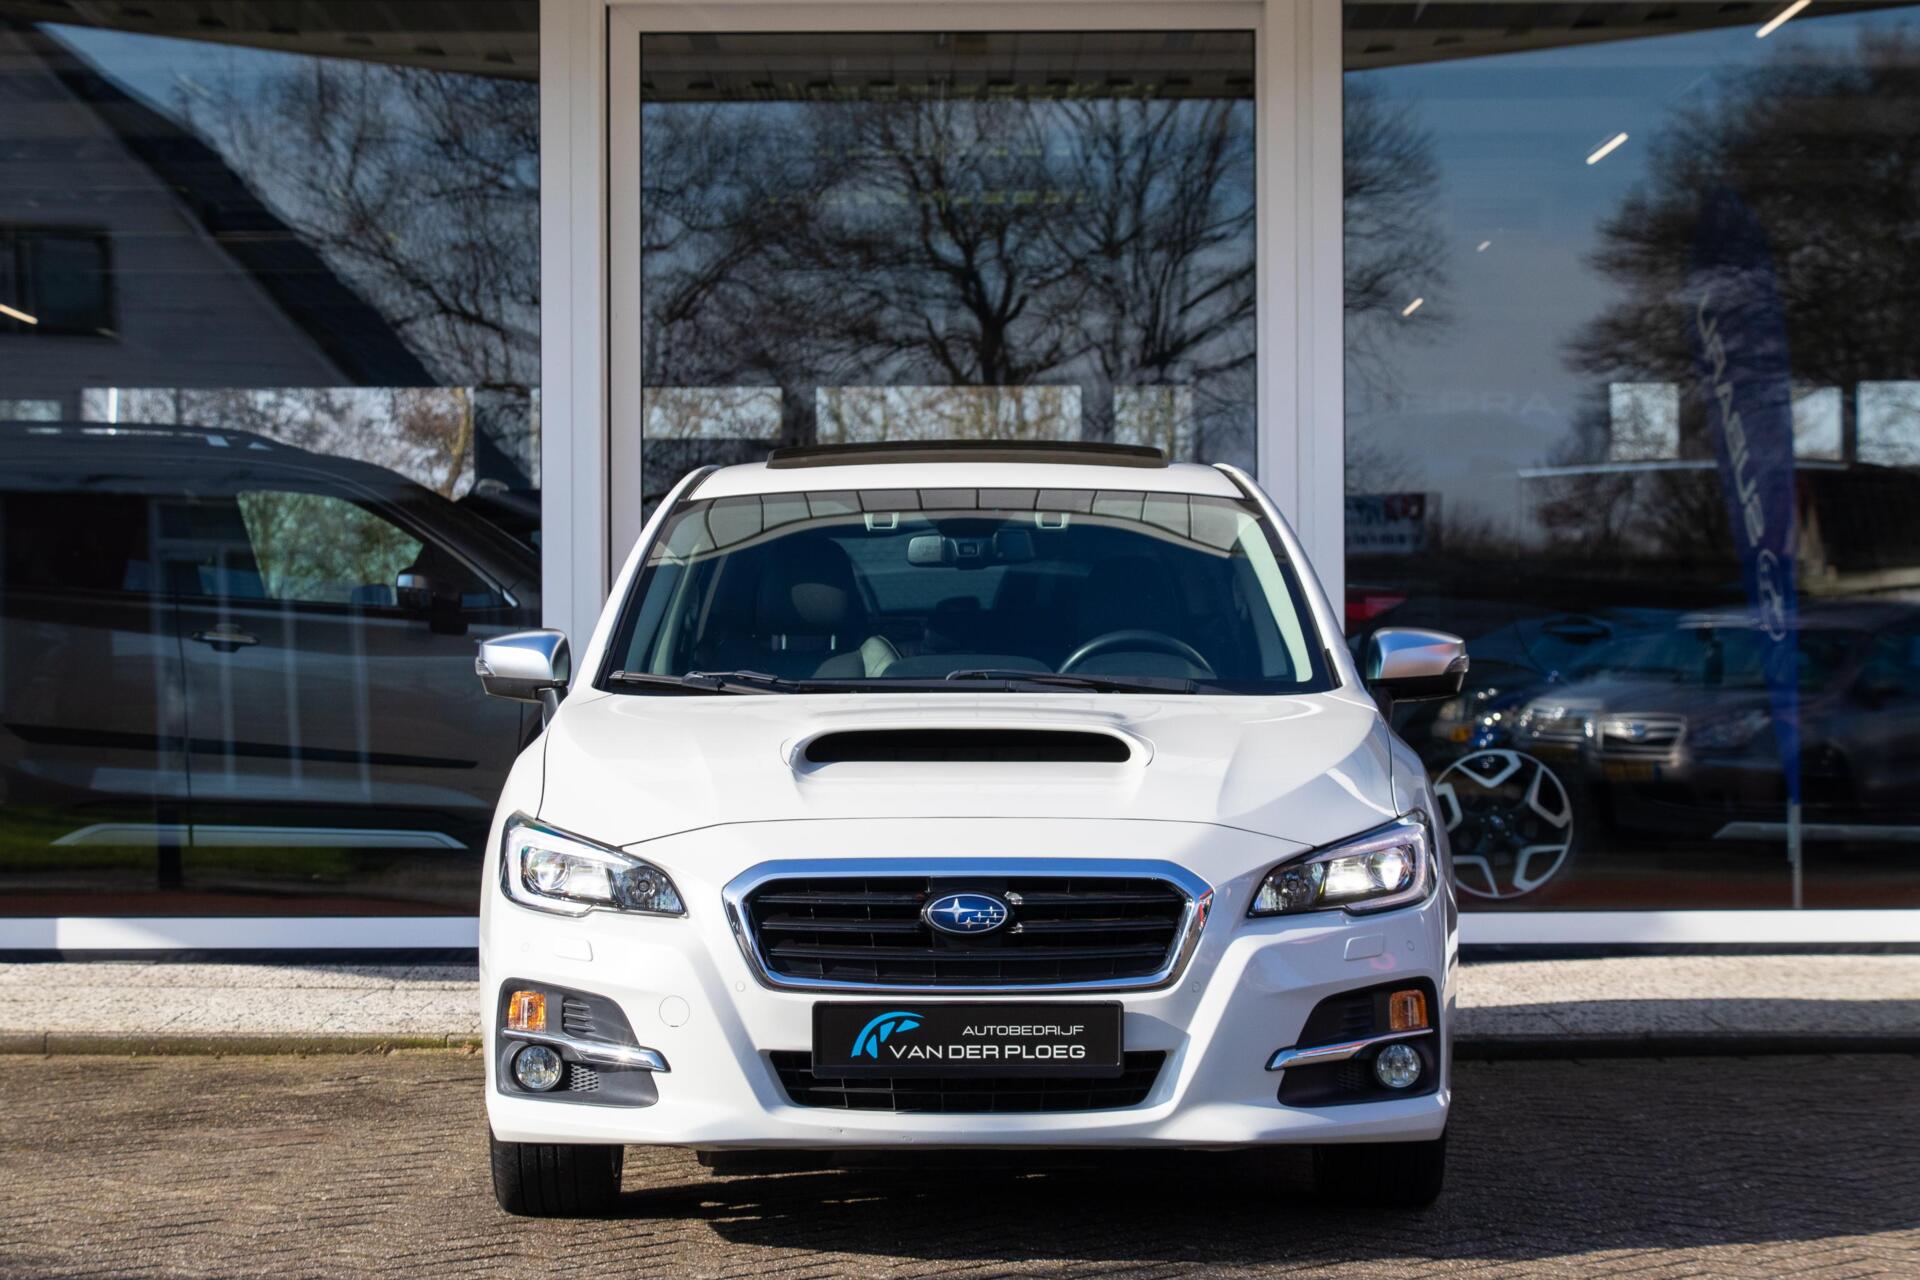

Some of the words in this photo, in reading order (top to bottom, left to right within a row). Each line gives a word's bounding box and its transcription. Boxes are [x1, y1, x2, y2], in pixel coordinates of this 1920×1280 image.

[962, 1025, 1085, 1036] AUTOBEDRIJF
[889, 1044, 943, 1060] VAN
[948, 1044, 1000, 1059] DER
[1004, 1044, 1086, 1059] PLOEG
